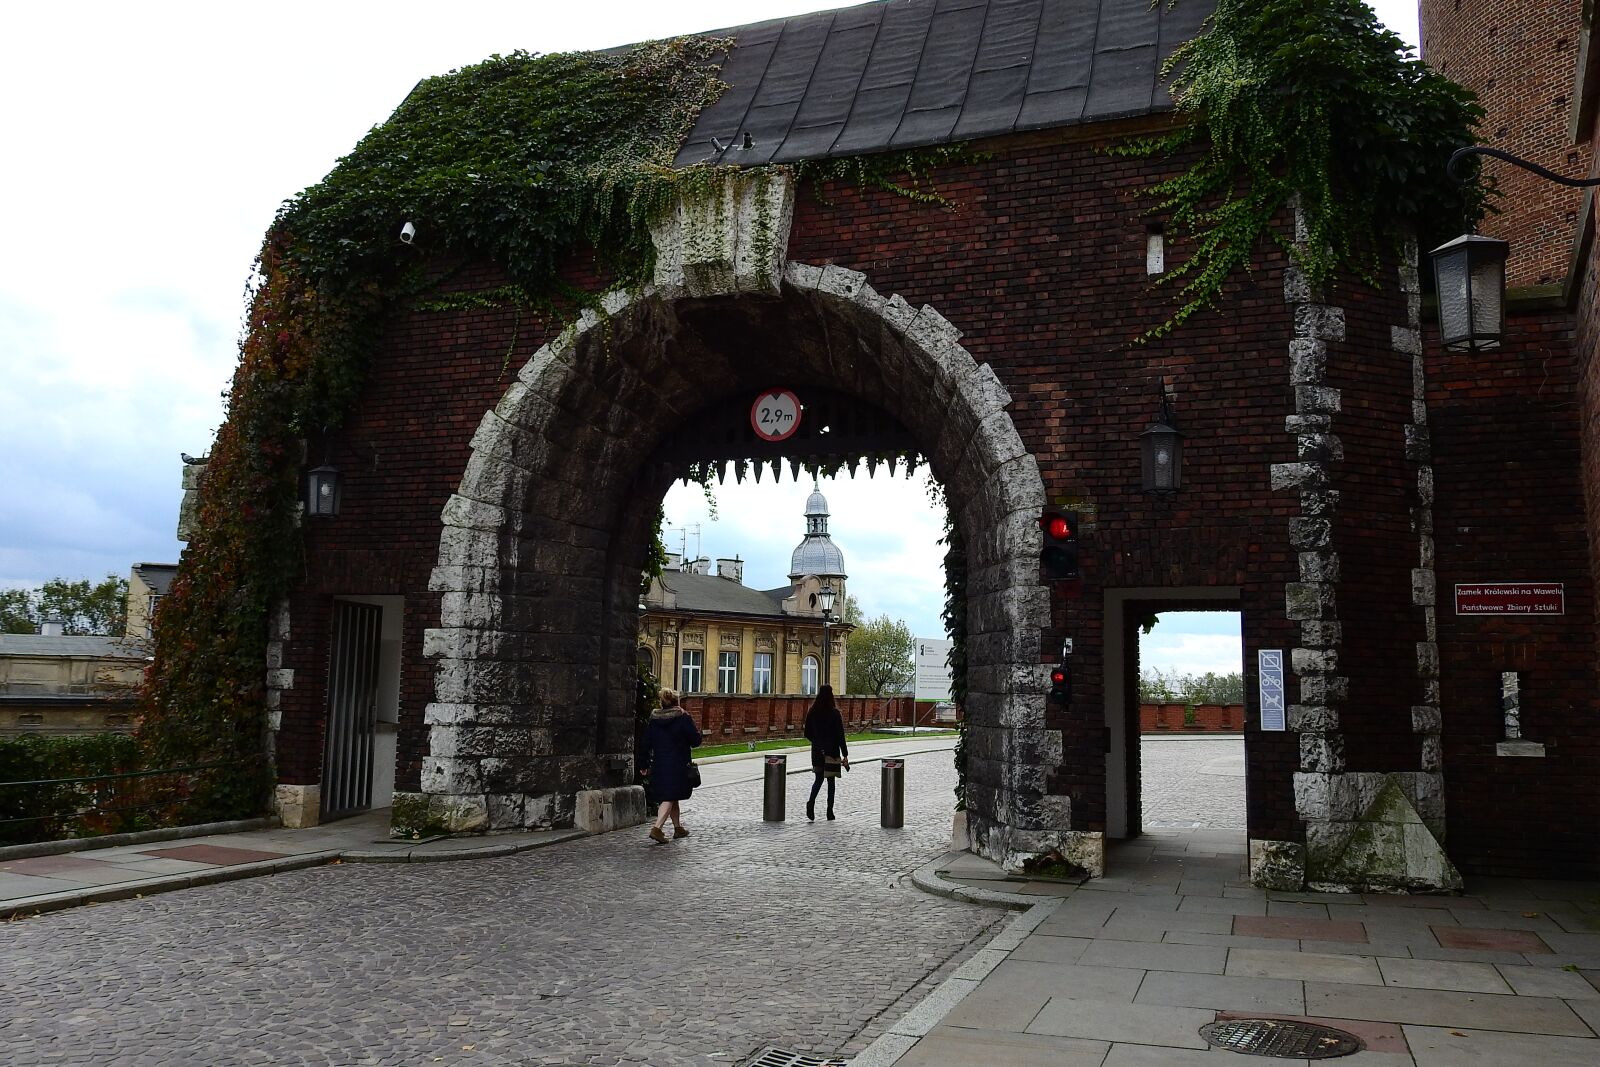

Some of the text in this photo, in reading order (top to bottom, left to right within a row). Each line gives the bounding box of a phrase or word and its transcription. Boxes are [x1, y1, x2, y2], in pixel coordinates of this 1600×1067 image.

[1457, 588, 1482, 596] Zamek
[1484, 587, 1520, 596] Królewski
[1533, 587, 1563, 595] Wawelu
[1461, 603, 1558, 613] Państwowe Zbiory Sztuki
